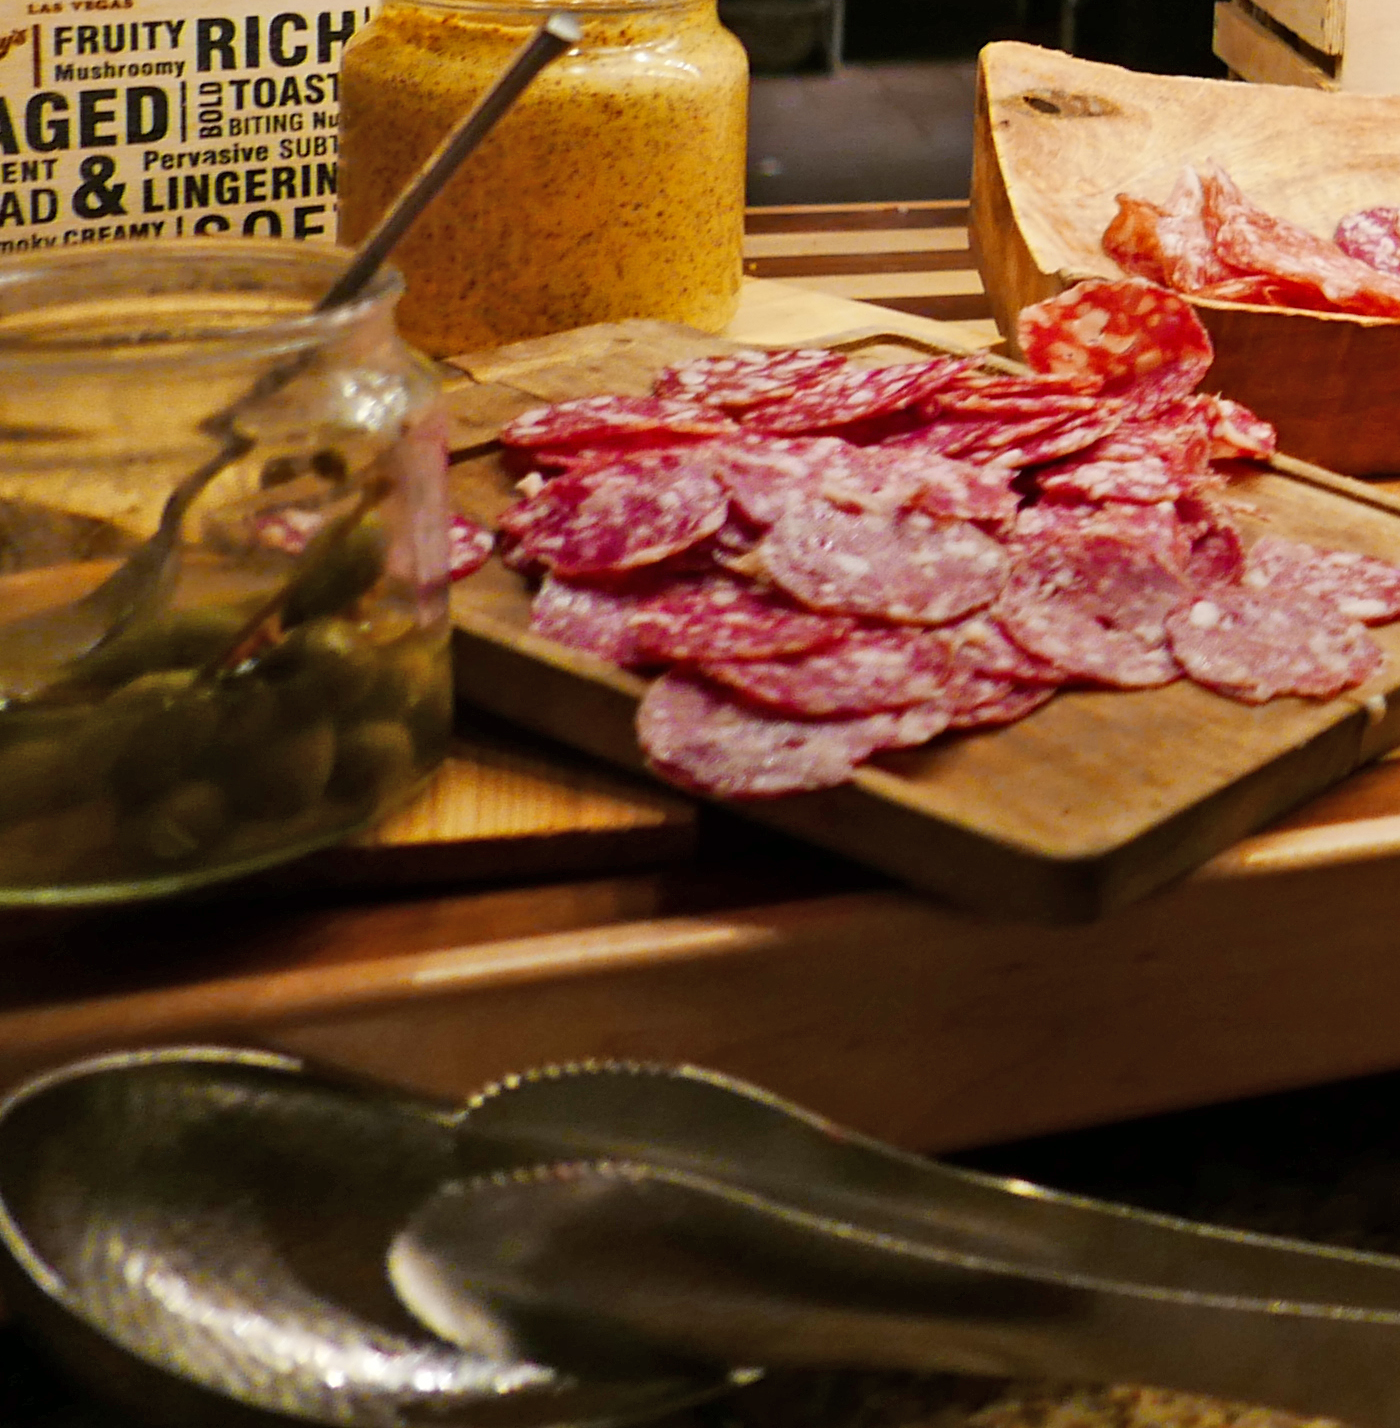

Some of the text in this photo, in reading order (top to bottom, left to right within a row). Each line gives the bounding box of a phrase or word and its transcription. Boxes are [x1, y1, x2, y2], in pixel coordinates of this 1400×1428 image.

[27, 3, 63, 15] LAS
[53, 19, 186, 56] FRUITY
[195, 9, 356, 73] RICH
[54, 59, 186, 83] Mushroomy
[198, 81, 223, 139] BOLD
[228, 72, 339, 111] TOAST
[228, 112, 303, 137] BITING
[143, 142, 269, 172] Pervasive
[71, 154, 128, 220] &
[0, 187, 58, 228] AD
[62, 220, 165, 248] CREAMY
